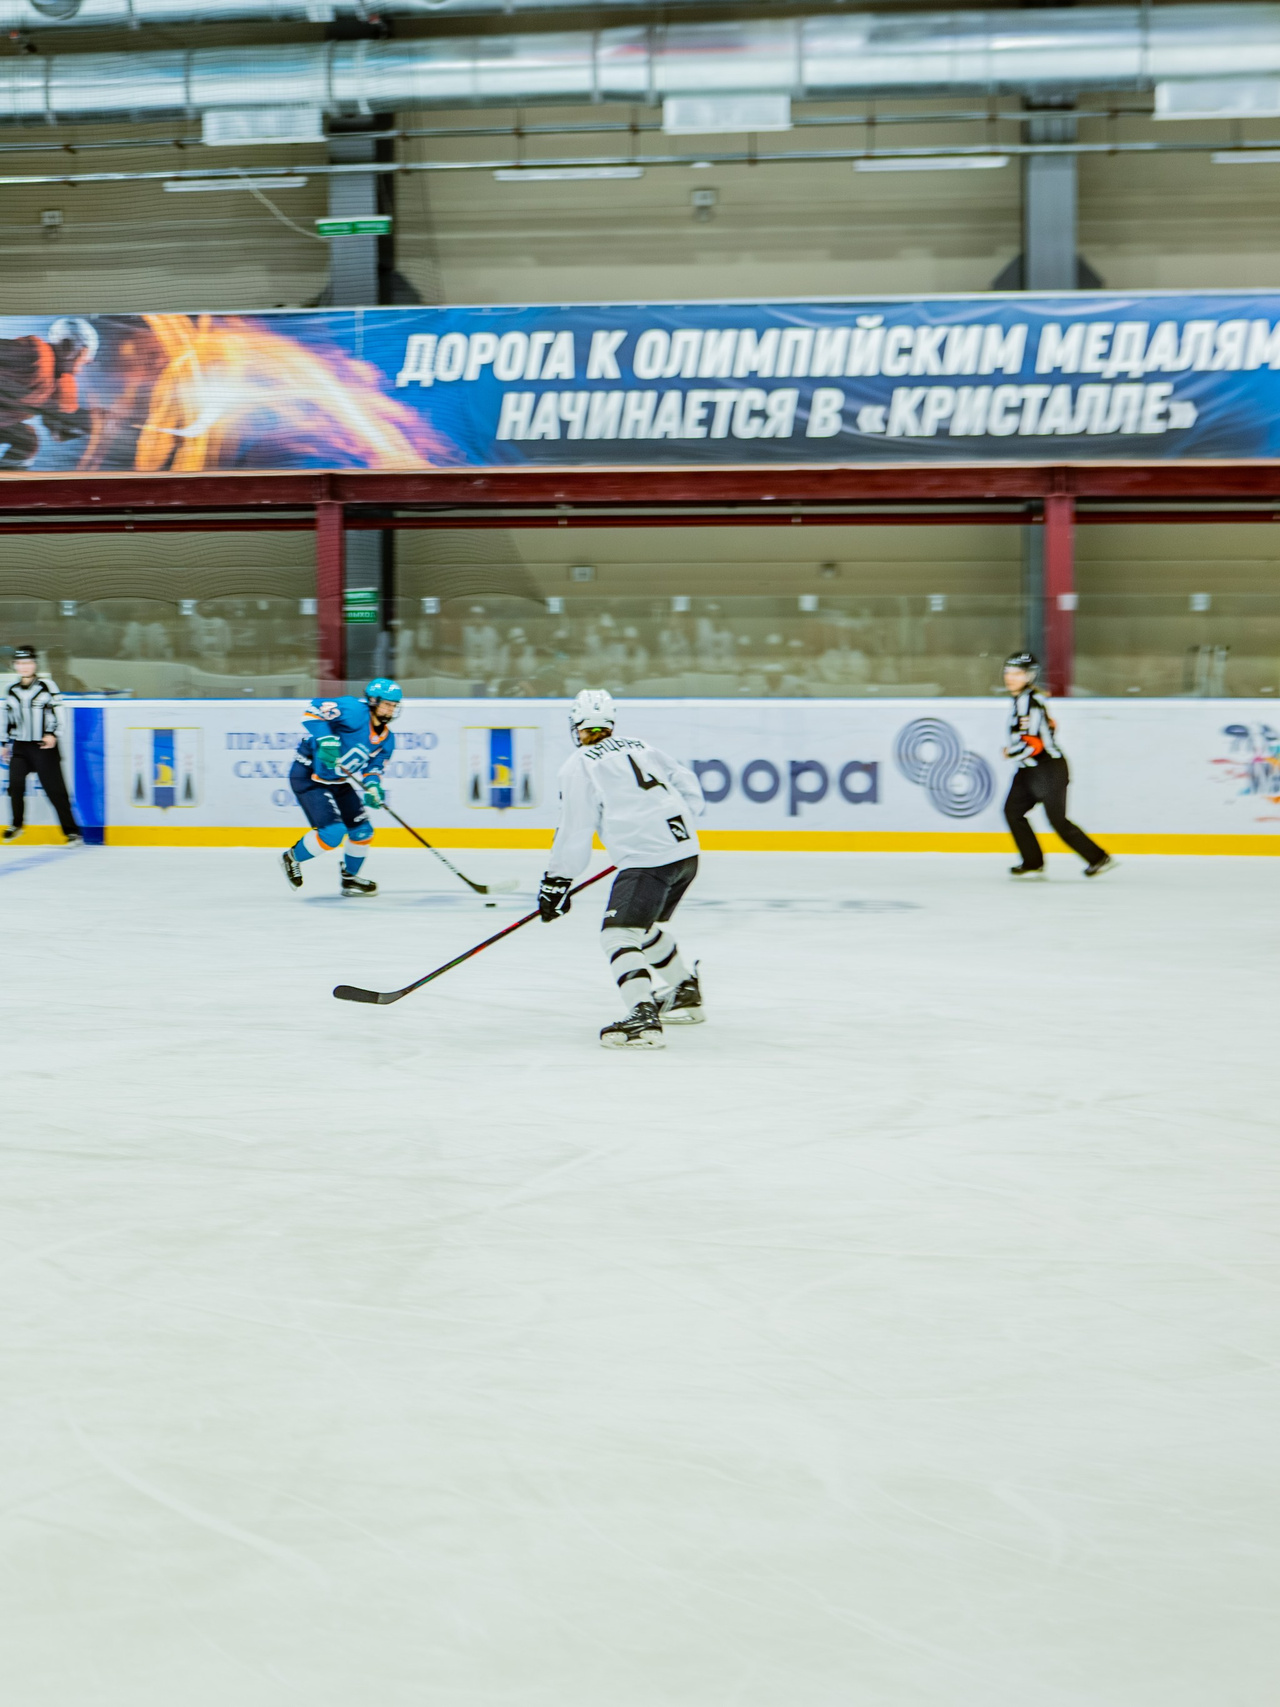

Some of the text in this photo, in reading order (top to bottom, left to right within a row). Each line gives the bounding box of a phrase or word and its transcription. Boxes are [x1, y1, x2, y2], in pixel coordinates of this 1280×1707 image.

[395, 330, 576, 387] ДОРОГА
[586, 329, 628, 379] К
[632, 315, 1029, 380] ОЛИМПИЙСКИМ
[496, 382, 1199, 441] НАЧИНАЕТСЯ В «КРИСТАЛЛЕ»
[627, 754, 668, 791] 4
[691, 759, 880, 817] рора
